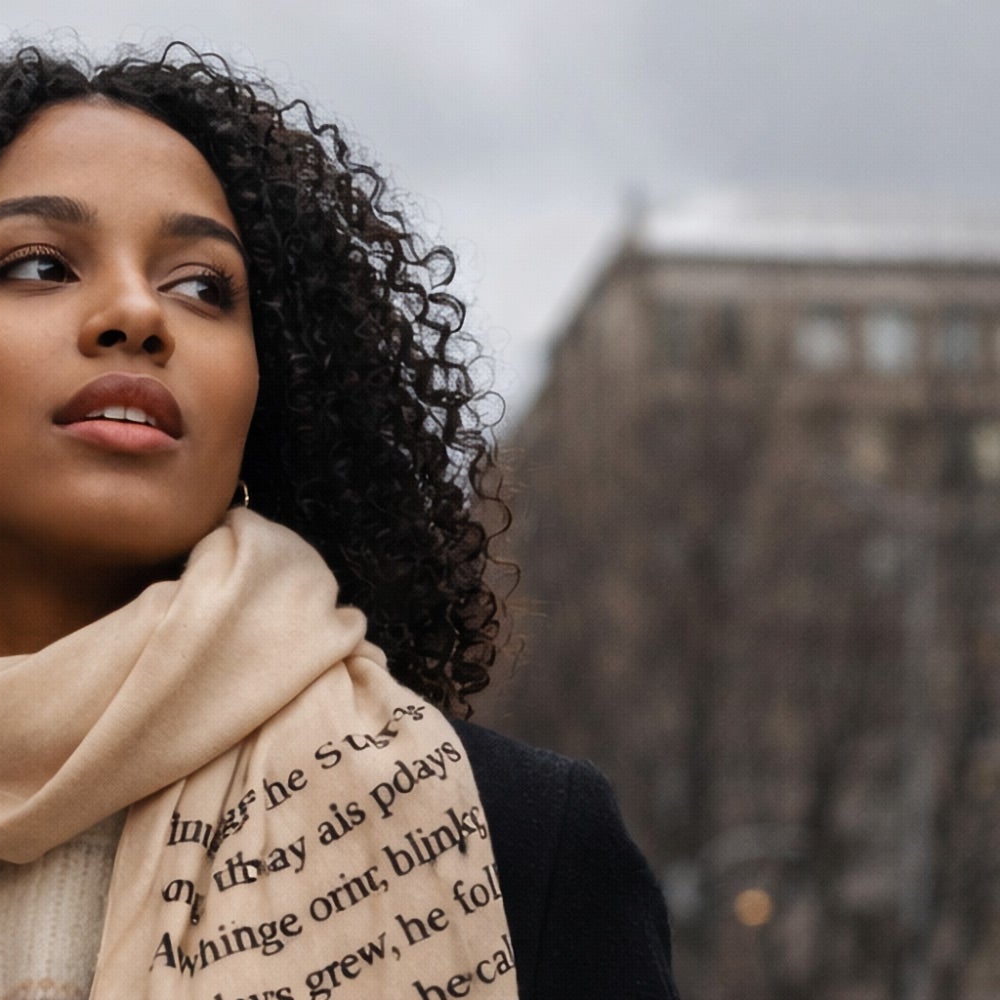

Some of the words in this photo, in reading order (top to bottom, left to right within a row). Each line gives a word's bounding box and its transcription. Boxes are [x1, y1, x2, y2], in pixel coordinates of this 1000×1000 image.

[317, 802, 366, 846] ais
[369, 741, 461, 819] pdays
[394, 907, 450, 946] he
